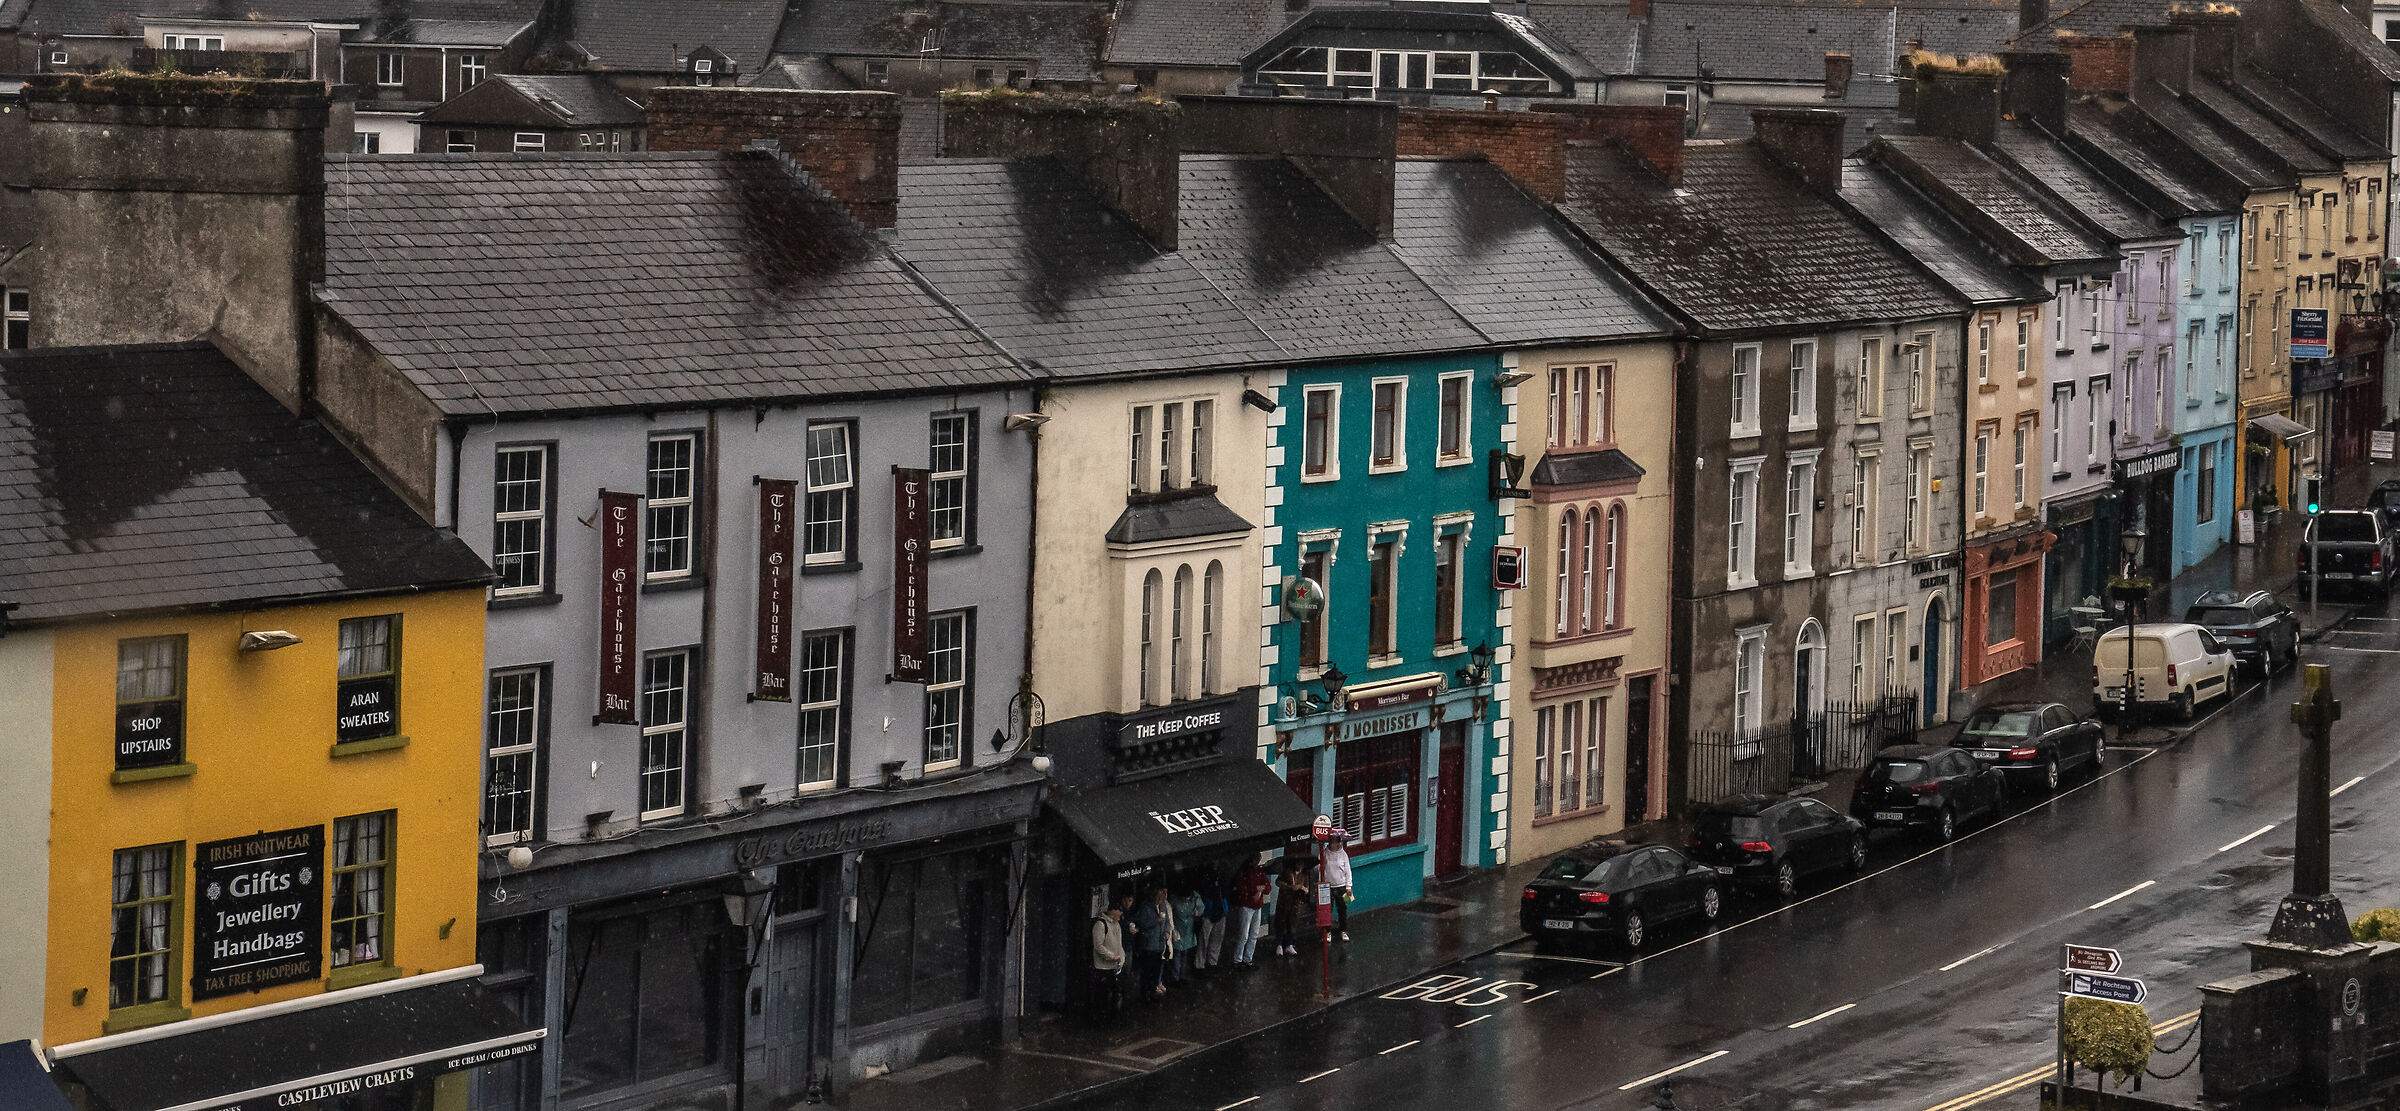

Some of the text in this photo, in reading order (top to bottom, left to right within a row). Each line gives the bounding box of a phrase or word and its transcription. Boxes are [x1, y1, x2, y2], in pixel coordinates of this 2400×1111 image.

[2127, 451, 2178, 478] BULLDOG BARBERS
[899, 481, 922, 671] The Gatehouse Bar
[761, 493, 786, 689] The Gatehouse Bar
[605, 506, 630, 711] The Gatehouse Bar
[350, 691, 379, 707] ARAN
[131, 717, 162, 732] SHOP
[340, 711, 390, 729] SWEATERS
[1136, 712, 1221, 739] THE KEEP COFFEE
[1343, 711, 1419, 739] J MORRISSEY
[121, 737, 172, 754] UPSTAIRS
[1152, 805, 1226, 834] KEEP
[1315, 827, 1329, 836] BUS
[210, 833, 310, 863] IRISH KNITWEAR
[229, 870, 290, 898] Gifts
[216, 902, 302, 933] Jewellery
[213, 931, 304, 959] Handbags
[205, 961, 311, 992] TAX FREE SHOPPING
[1377, 974, 1539, 1007] BUS
[2092, 988, 2112, 996] Access
[447, 1060, 460, 1069] ICE
[461, 1053, 486, 1066] CREAM
[491, 1048, 511, 1060] COLD
[511, 1043, 537, 1055] DRINKS
[278, 1066, 415, 1107] CASTLEVIEW CRAFTS
